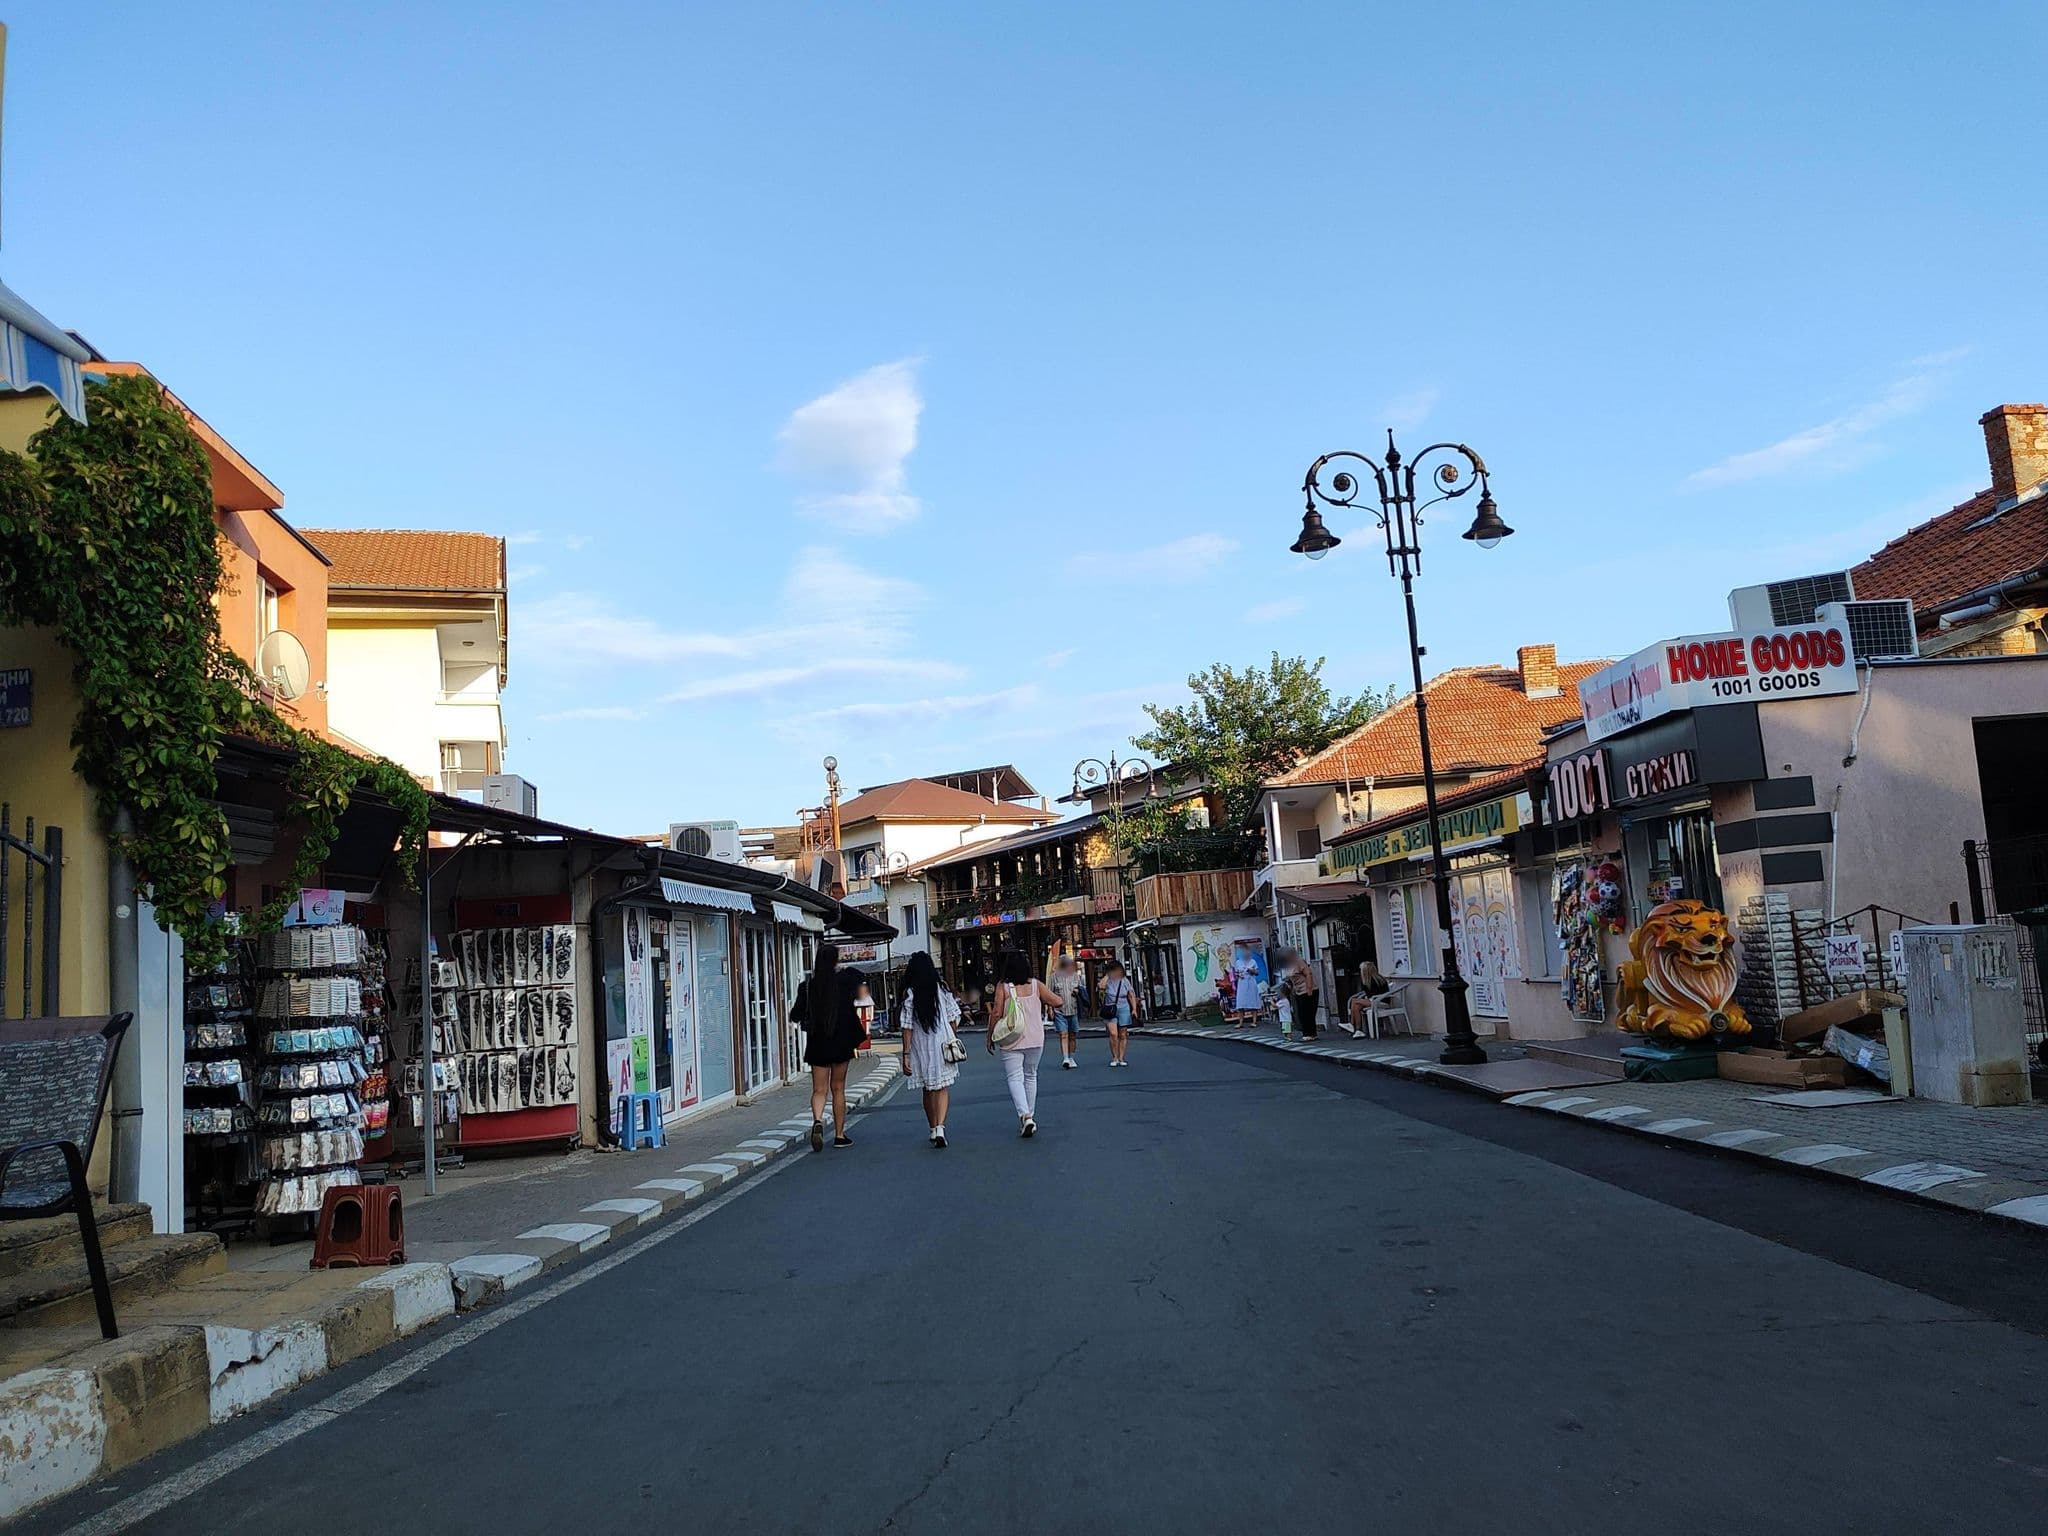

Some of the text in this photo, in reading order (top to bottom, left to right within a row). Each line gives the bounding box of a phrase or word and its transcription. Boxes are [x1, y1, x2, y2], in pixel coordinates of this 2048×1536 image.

[1666, 638, 1749, 684] HOME
[1751, 628, 1845, 674] GOODS
[1712, 671, 1820, 697] 1001 GOODS
[1549, 749, 1690, 821] 1001 СТОКИ
[1332, 836, 1389, 869] ПЛОДОВЕ
[1402, 802, 1504, 852] ЗЕЛНЧУЦИ
